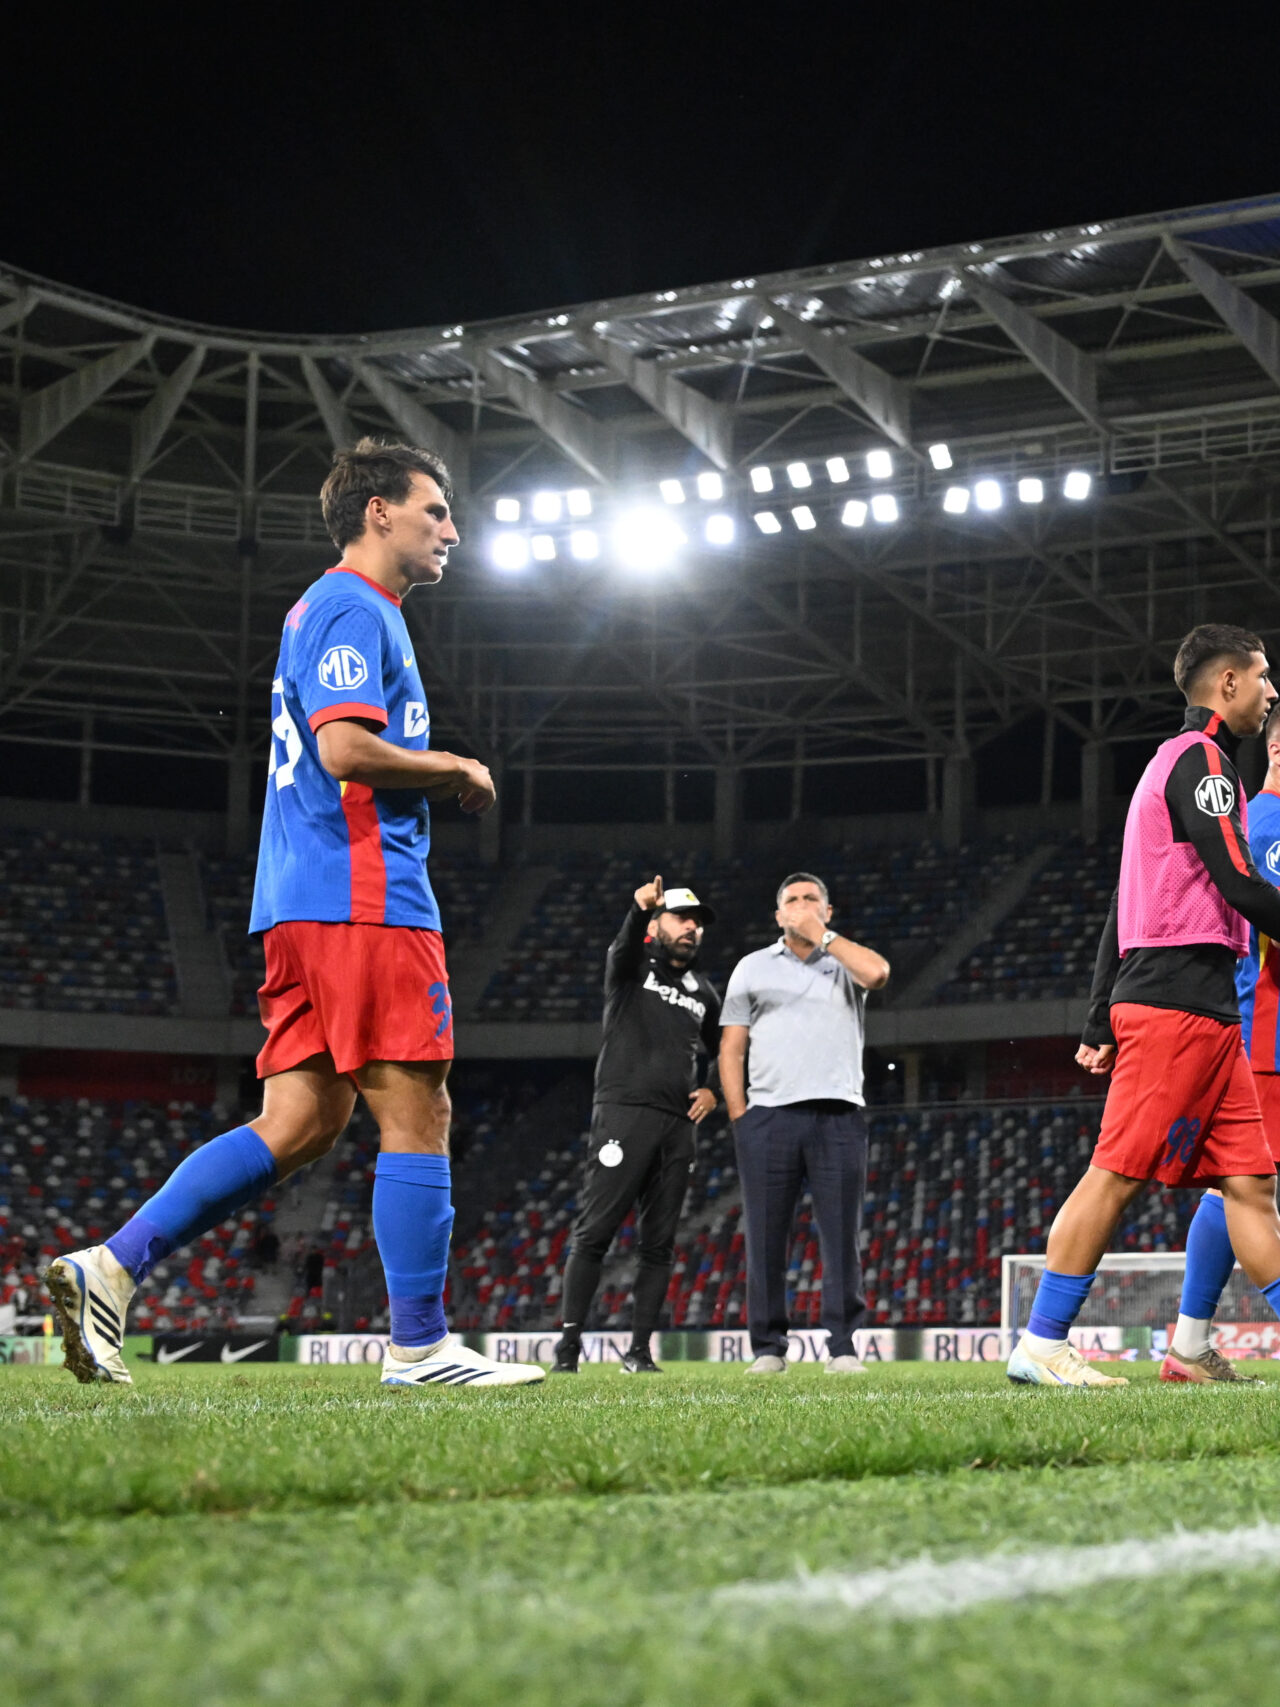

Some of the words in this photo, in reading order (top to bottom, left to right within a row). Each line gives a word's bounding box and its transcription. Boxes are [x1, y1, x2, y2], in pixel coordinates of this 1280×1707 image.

[321, 648, 365, 688] MG
[1198, 777, 1232, 813] MG
[427, 981, 453, 1040] 3
[1161, 1116, 1200, 1165] 98
[496, 1338, 629, 1363] BUCVIN
